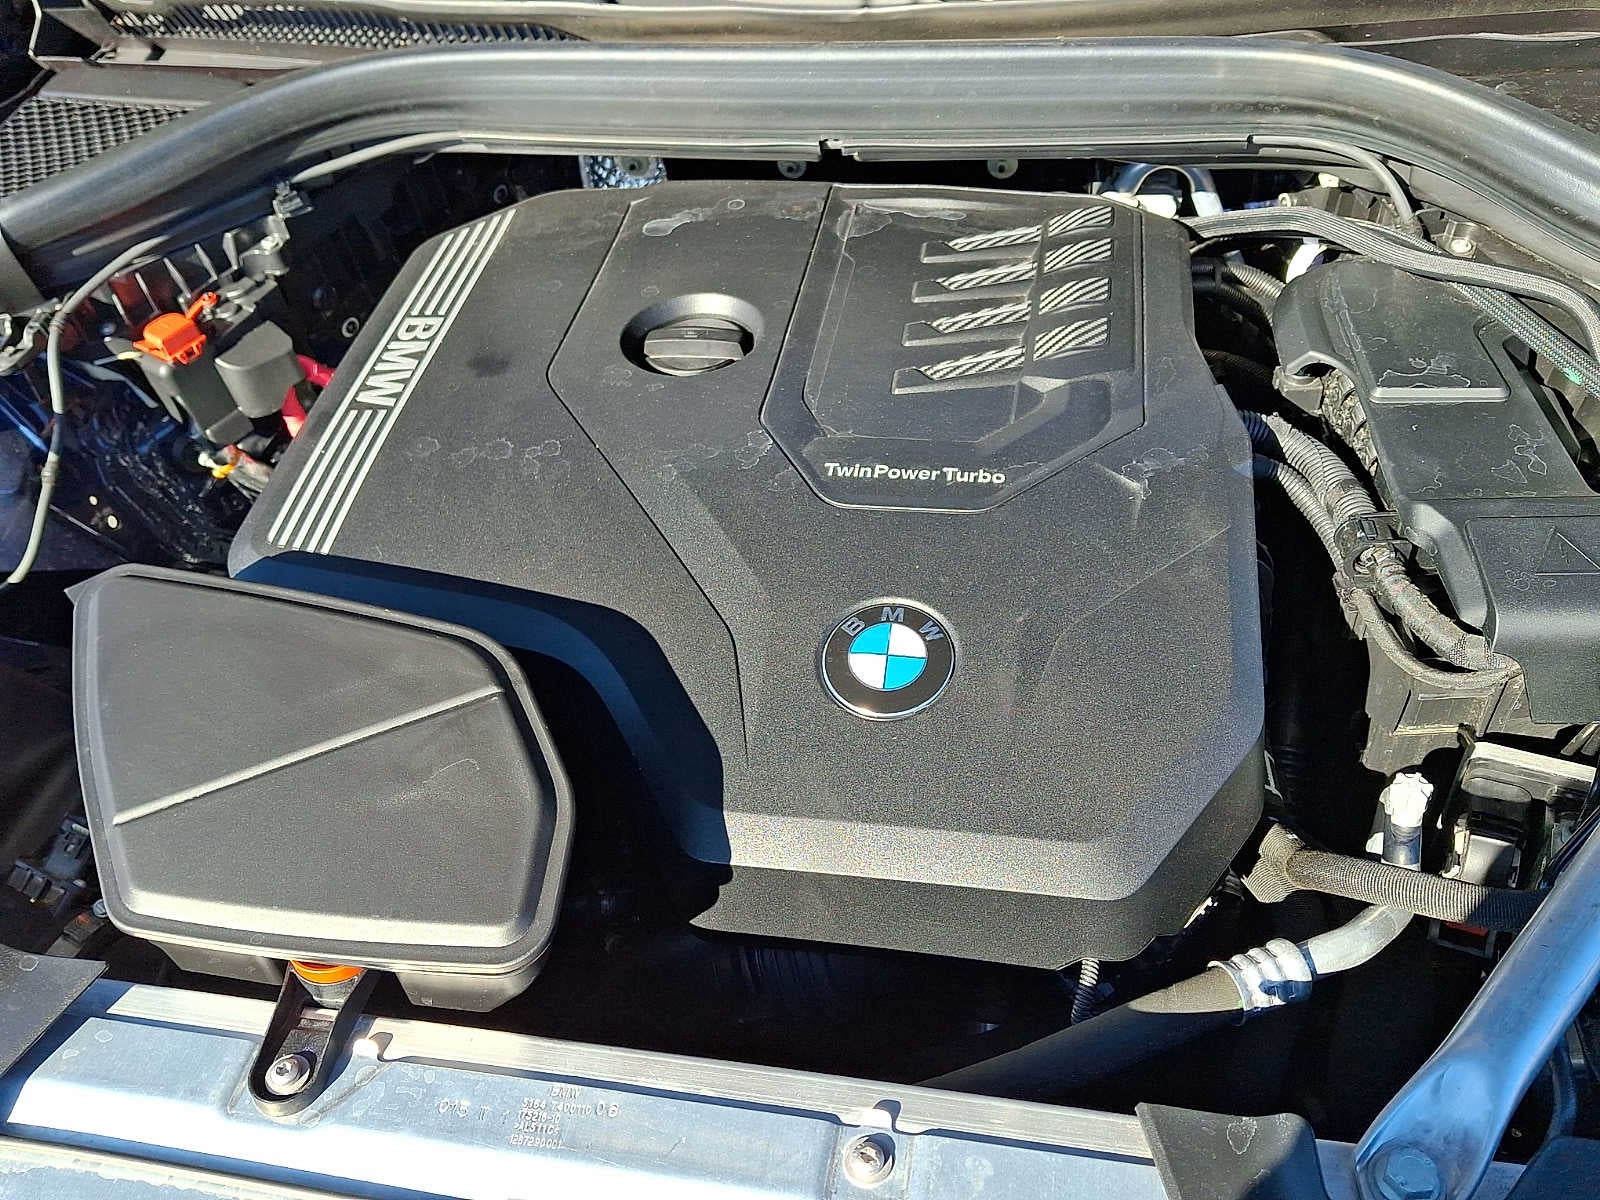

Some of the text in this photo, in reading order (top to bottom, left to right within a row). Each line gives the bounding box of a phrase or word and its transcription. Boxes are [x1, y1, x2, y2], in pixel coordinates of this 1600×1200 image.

[355, 316, 446, 407] BMW
[824, 462, 1006, 484] TwinPower Turbo
[840, 606, 944, 641] BMW
